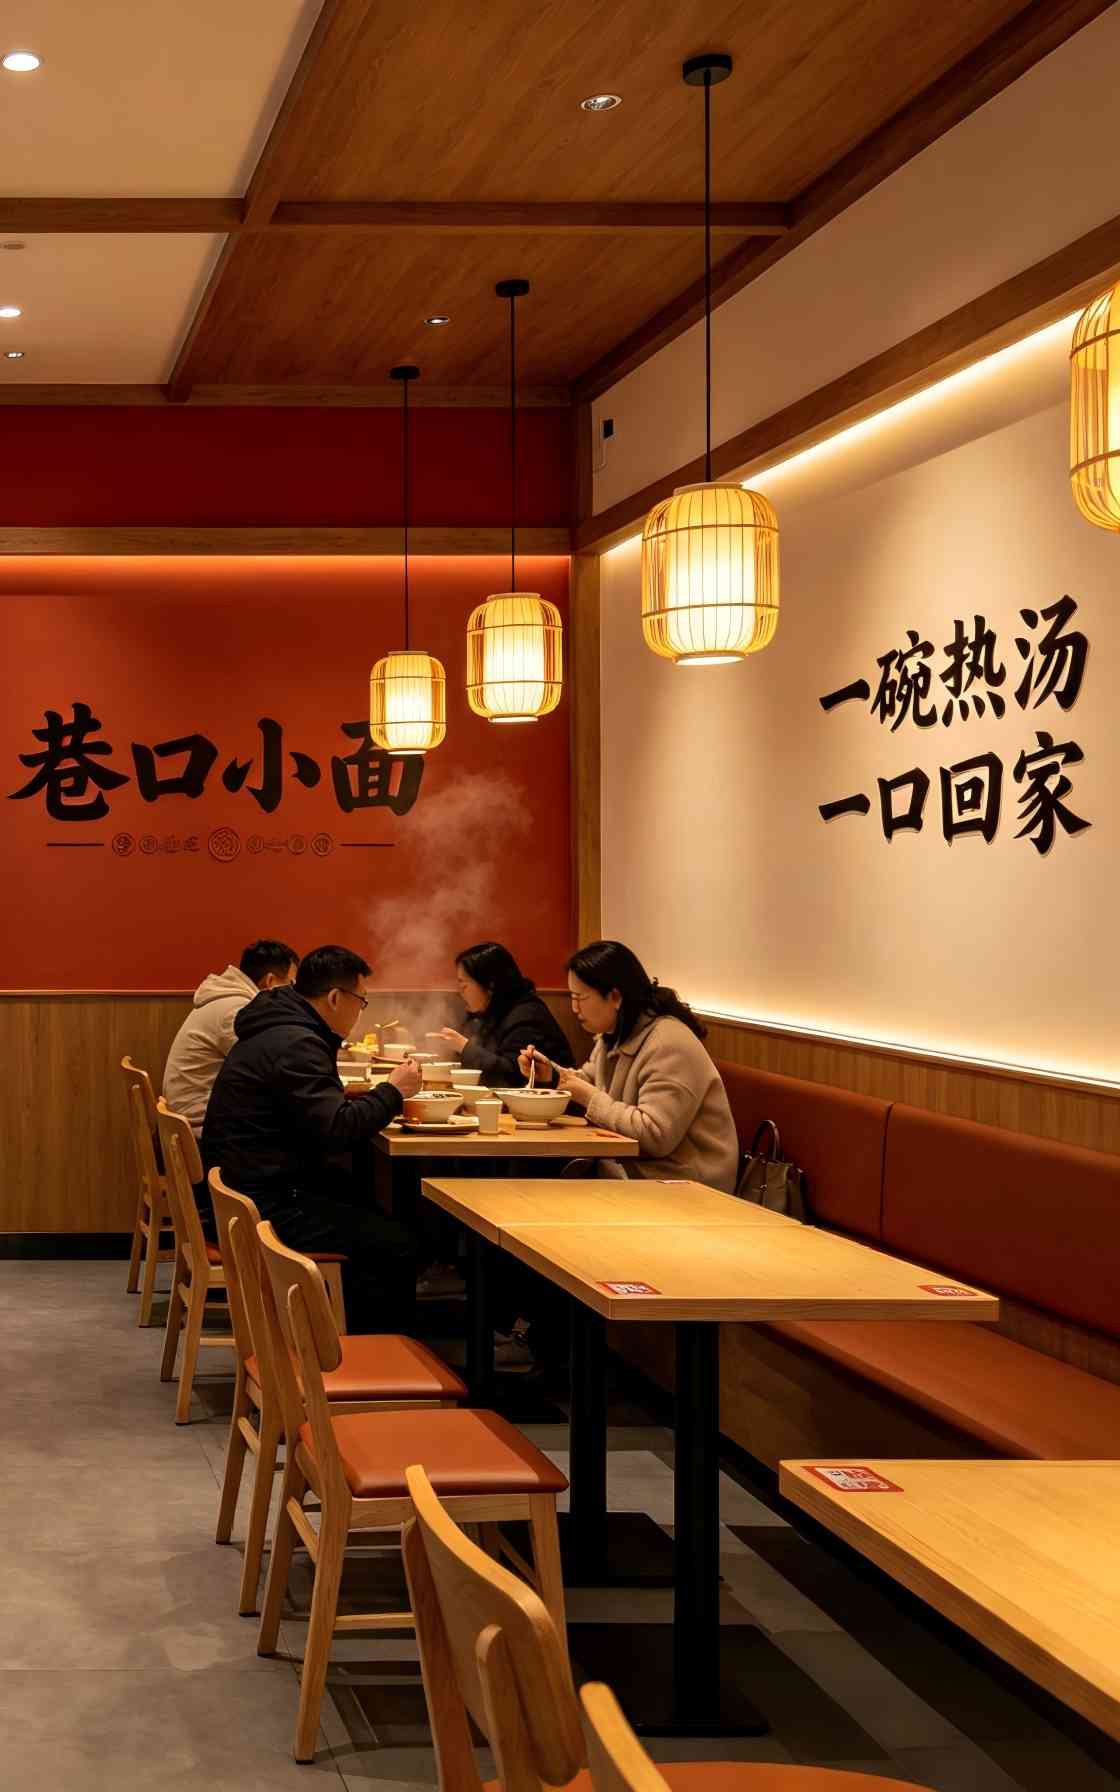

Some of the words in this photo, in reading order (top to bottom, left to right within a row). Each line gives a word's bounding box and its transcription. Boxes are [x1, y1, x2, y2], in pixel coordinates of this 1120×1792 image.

[818, 594, 1088, 732] 一碗热汤
[8, 702, 425, 822] 巷口小面
[818, 731, 1092, 856] 一口回家
